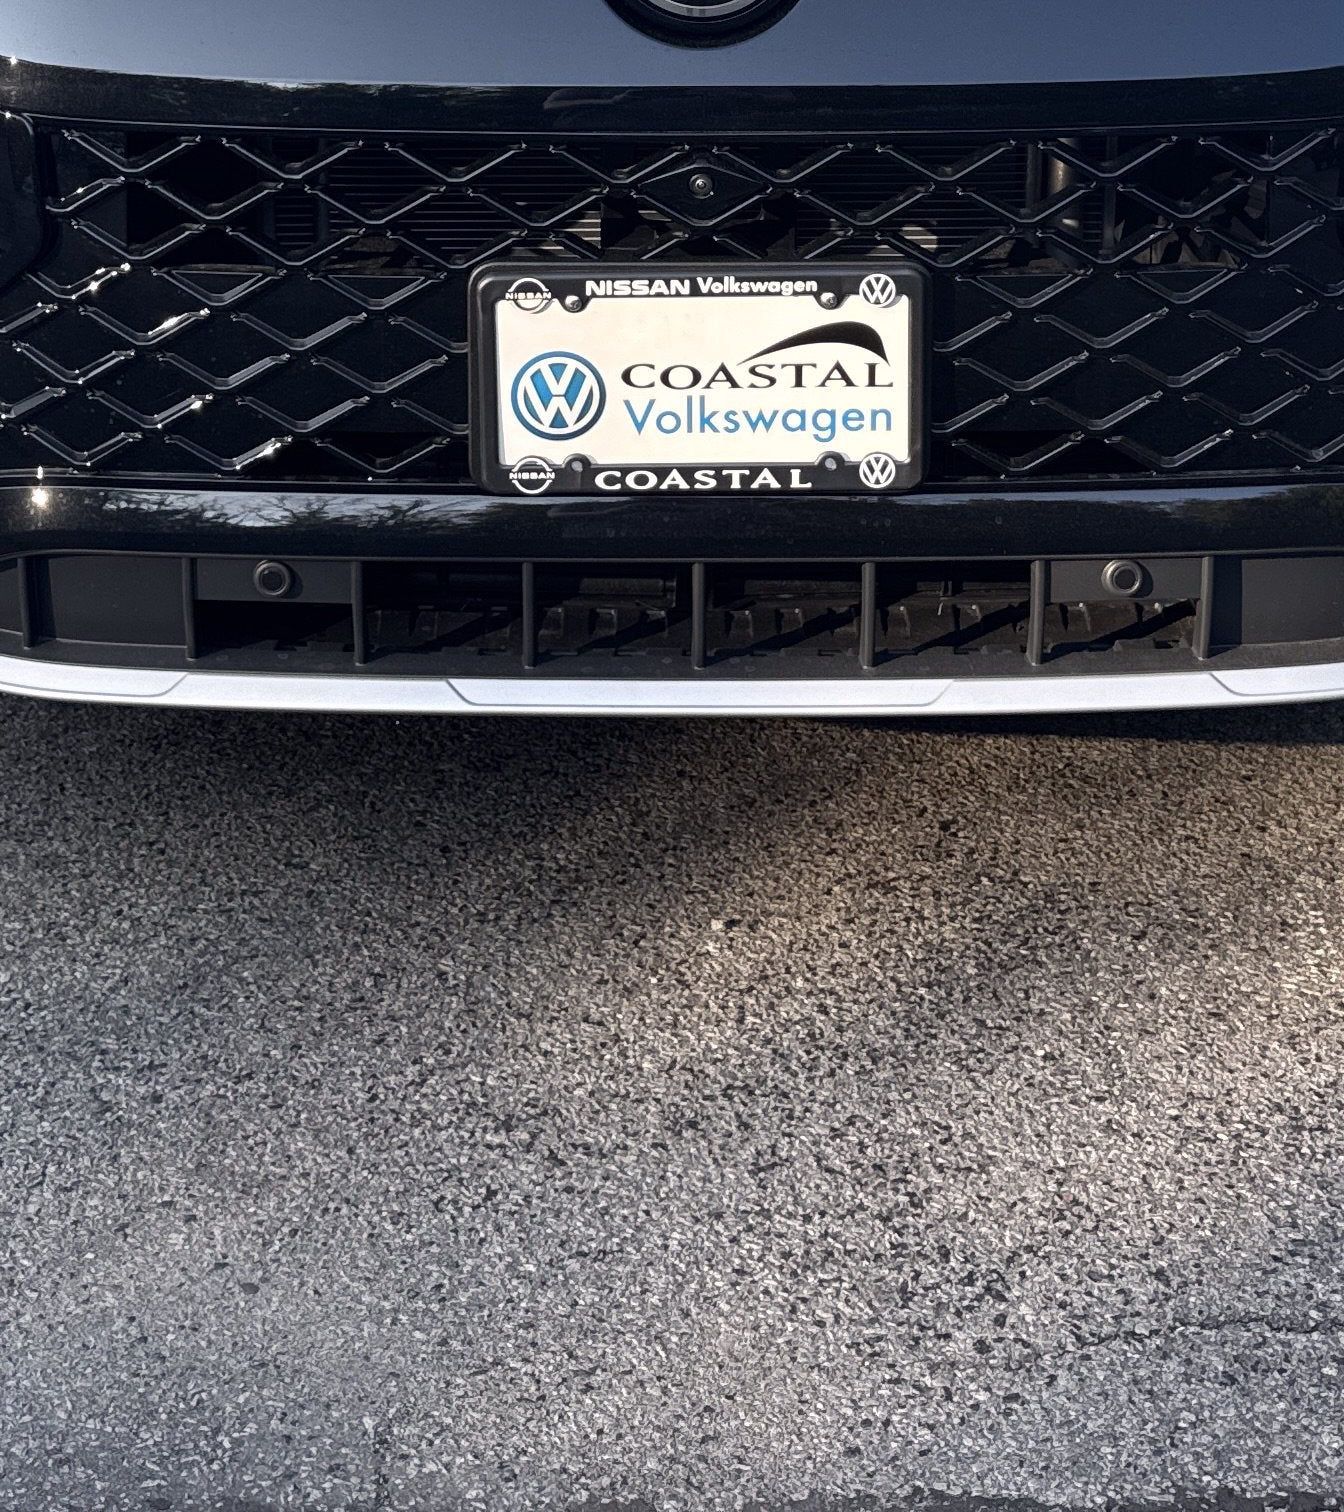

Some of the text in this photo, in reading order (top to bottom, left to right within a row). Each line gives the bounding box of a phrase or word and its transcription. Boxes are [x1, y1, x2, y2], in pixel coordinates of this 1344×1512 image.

[585, 276, 818, 297] NISSAN Volkswagen
[620, 360, 894, 389] COASTAL
[623, 395, 892, 443] Volkswagen
[509, 471, 556, 480] NISSAN
[594, 467, 813, 490] COASTAL
